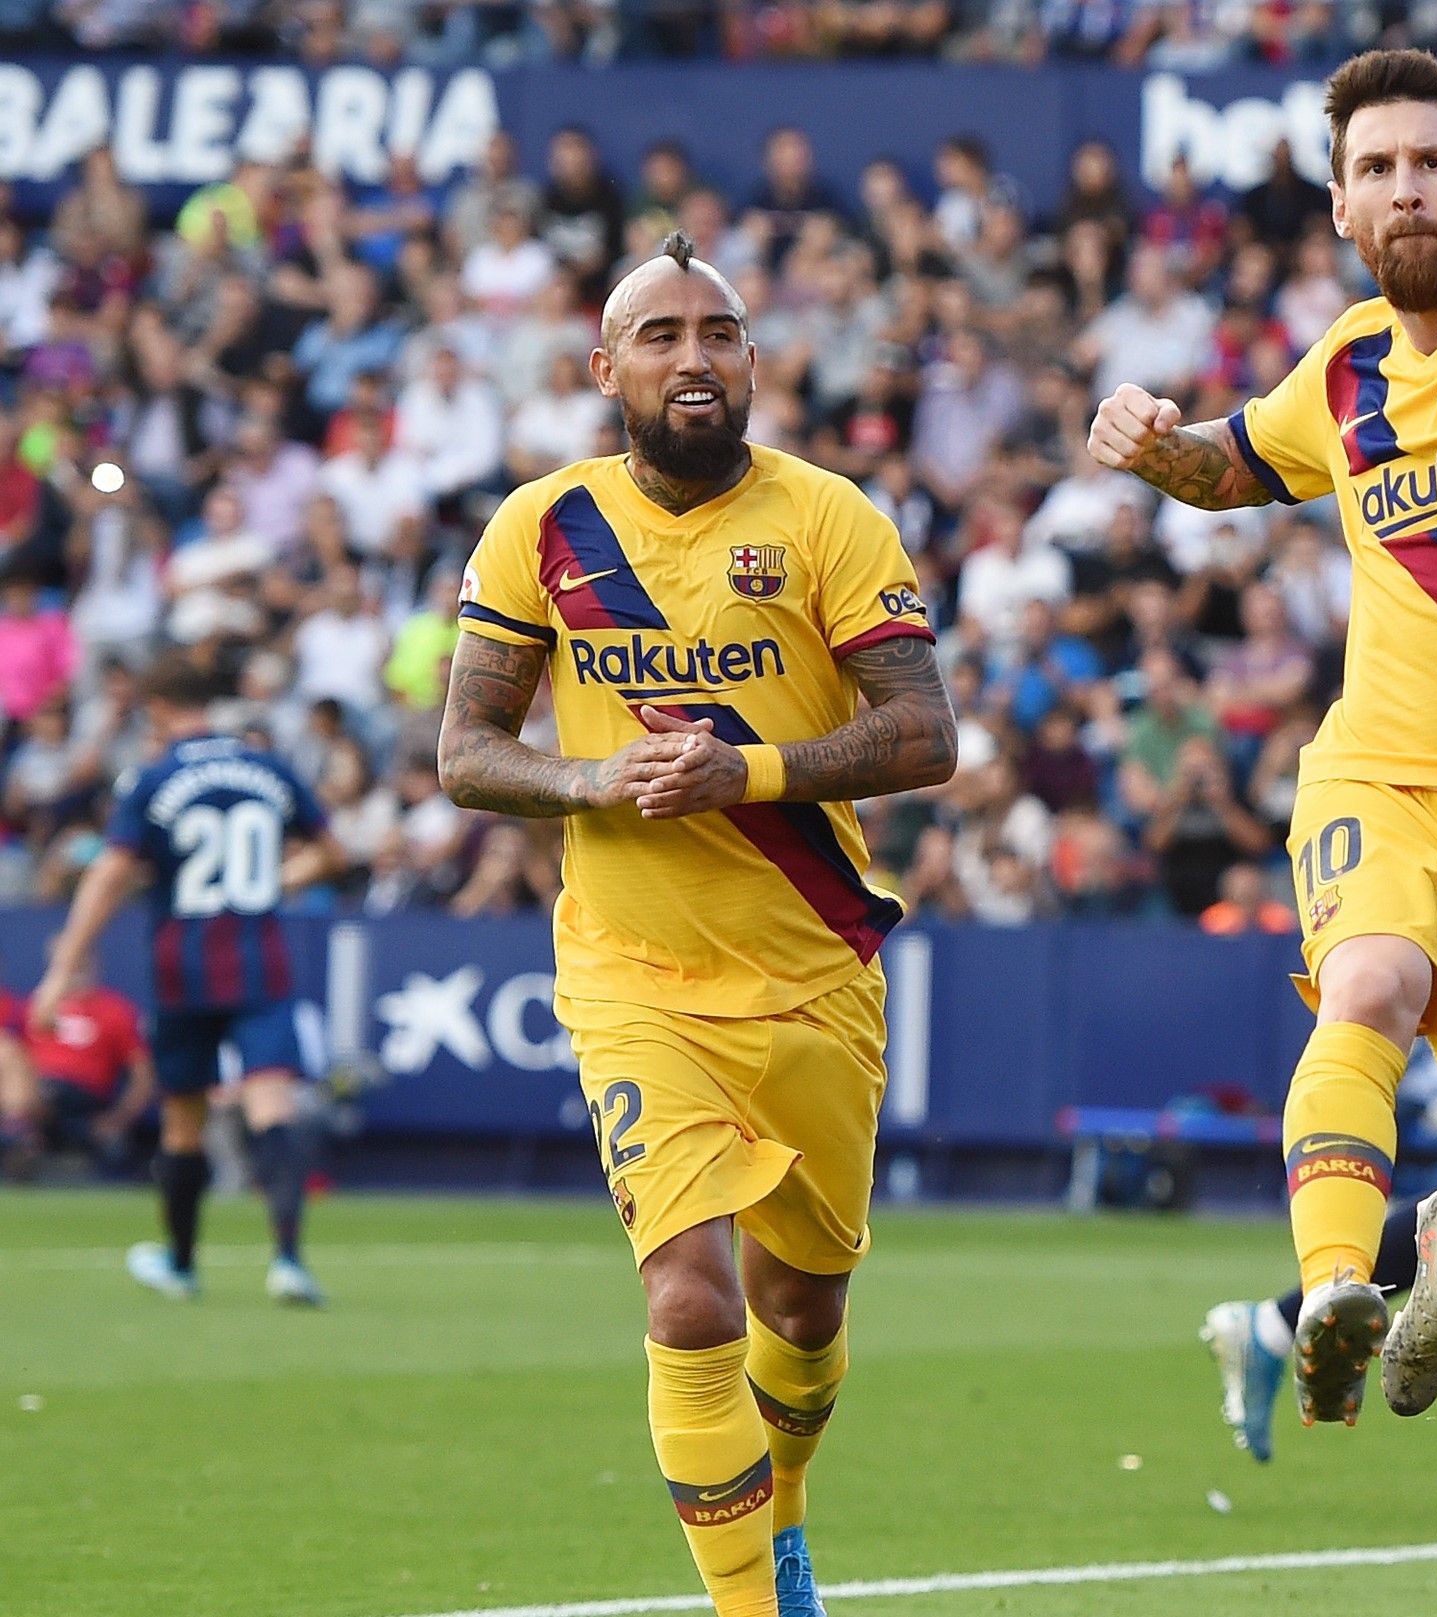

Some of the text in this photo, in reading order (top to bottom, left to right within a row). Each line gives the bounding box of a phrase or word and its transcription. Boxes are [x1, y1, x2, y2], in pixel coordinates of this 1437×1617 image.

[569, 634, 785, 685] Rakuten
[171, 799, 284, 918] 20
[1299, 816, 1361, 903] 10
[695, 1488, 766, 1522] BARÇA
